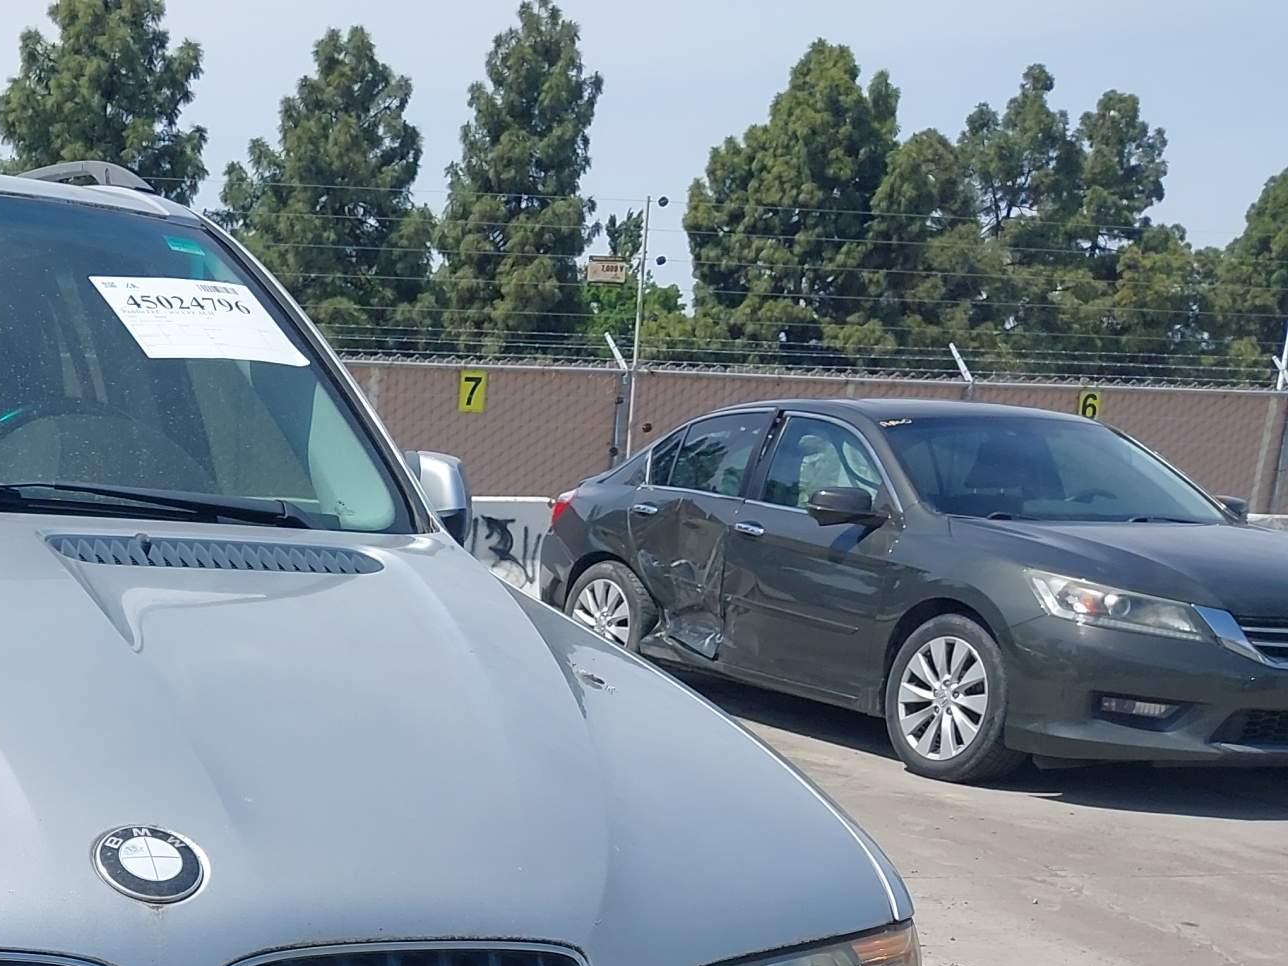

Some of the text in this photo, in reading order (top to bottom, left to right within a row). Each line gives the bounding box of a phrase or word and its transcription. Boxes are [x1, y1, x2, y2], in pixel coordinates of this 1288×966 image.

[126, 295, 252, 316] 45024796
[464, 376, 482, 406] 7
[1082, 393, 1097, 419] 6
[104, 828, 186, 849] BMW
